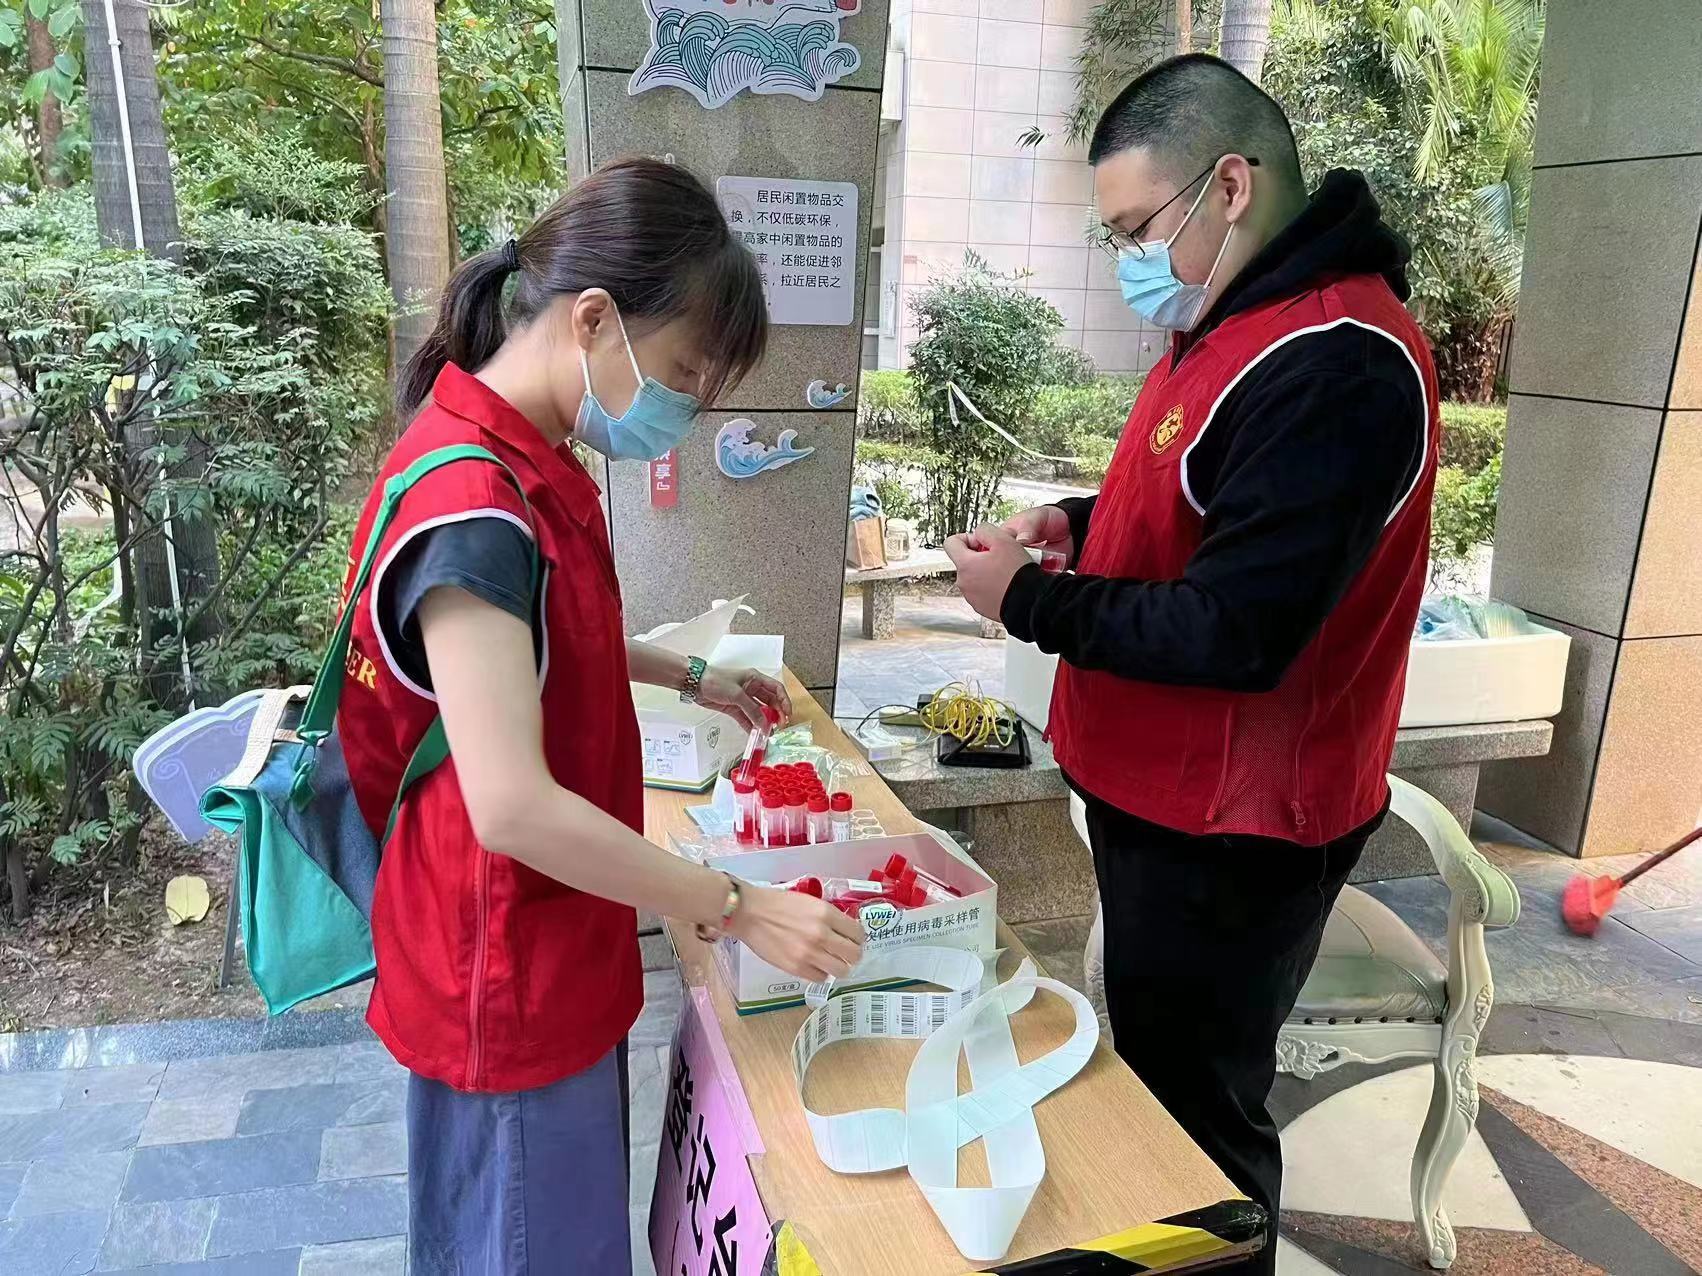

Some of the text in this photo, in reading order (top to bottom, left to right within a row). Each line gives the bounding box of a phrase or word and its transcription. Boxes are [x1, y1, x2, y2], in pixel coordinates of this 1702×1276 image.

[757, 190, 844, 207] 居民闲置物品交
[731, 210, 839, 228] 换，不仅低碳环保，
[865, 910, 897, 920] LVWEI
